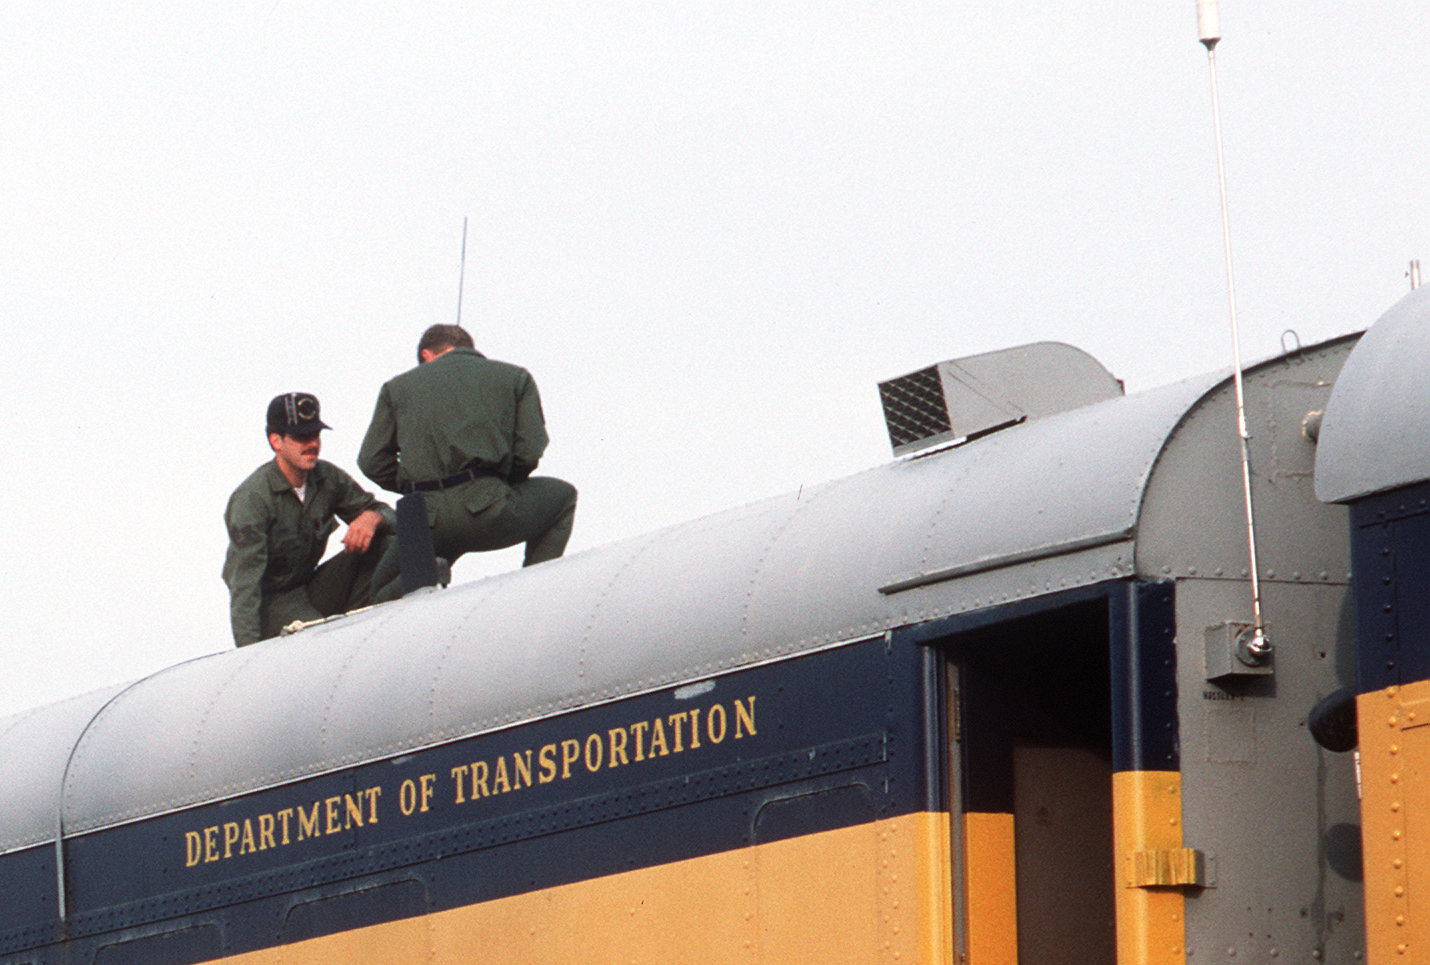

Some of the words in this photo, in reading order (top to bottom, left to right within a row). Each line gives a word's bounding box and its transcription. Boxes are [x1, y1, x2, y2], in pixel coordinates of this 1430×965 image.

[185, 787, 382, 867] DEPARTMENT
[400, 773, 436, 816] OF
[451, 696, 757, 803] TRANSPORTATION
